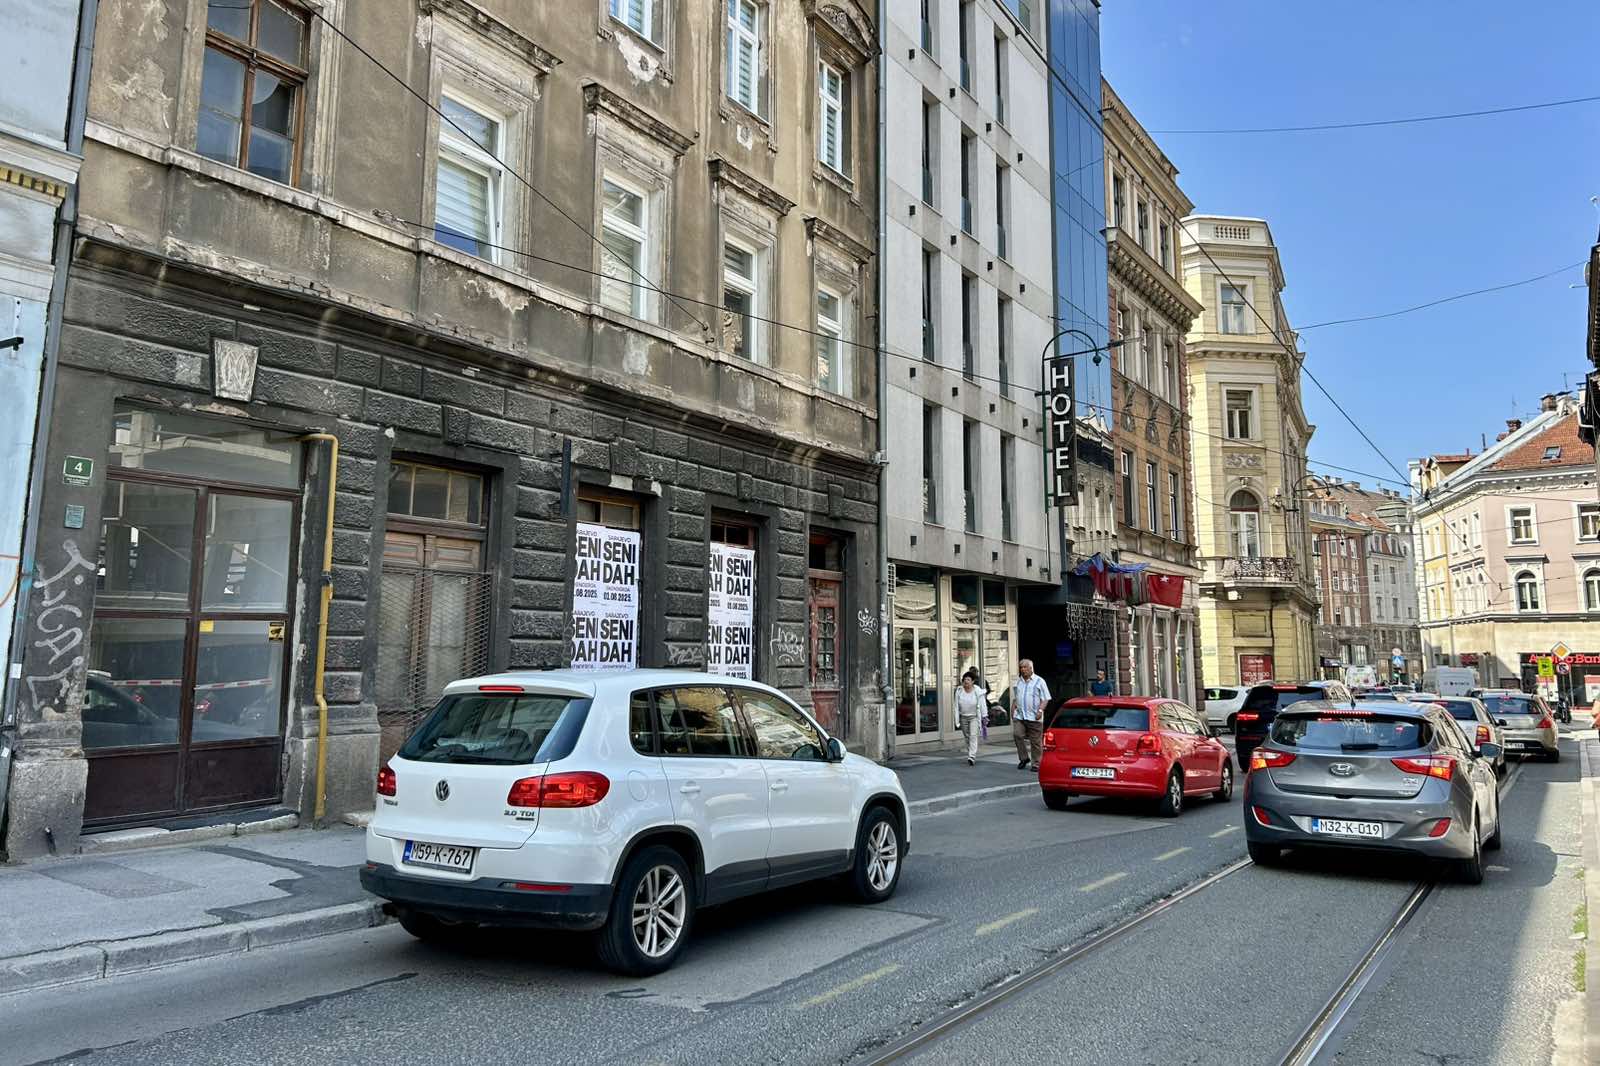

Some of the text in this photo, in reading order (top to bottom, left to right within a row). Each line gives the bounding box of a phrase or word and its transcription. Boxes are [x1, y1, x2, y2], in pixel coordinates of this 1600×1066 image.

[1051, 365, 1072, 497] HOTEL
[74, 462, 84, 473] 4
[577, 536, 636, 564] ENI SENI
[577, 559, 635, 586] AH DAH
[726, 557, 752, 578] SENI
[726, 576, 751, 596] DAH
[600, 618, 633, 640] SENI
[725, 626, 750, 645] SENI
[600, 641, 632, 662] DAH
[707, 645, 721, 664] AH
[725, 646, 750, 665] DAH
[1575, 653, 1600, 664] Ban
[1320, 820, 1380, 836] M32-K-019
[411, 842, 471, 867] M59-K-767
